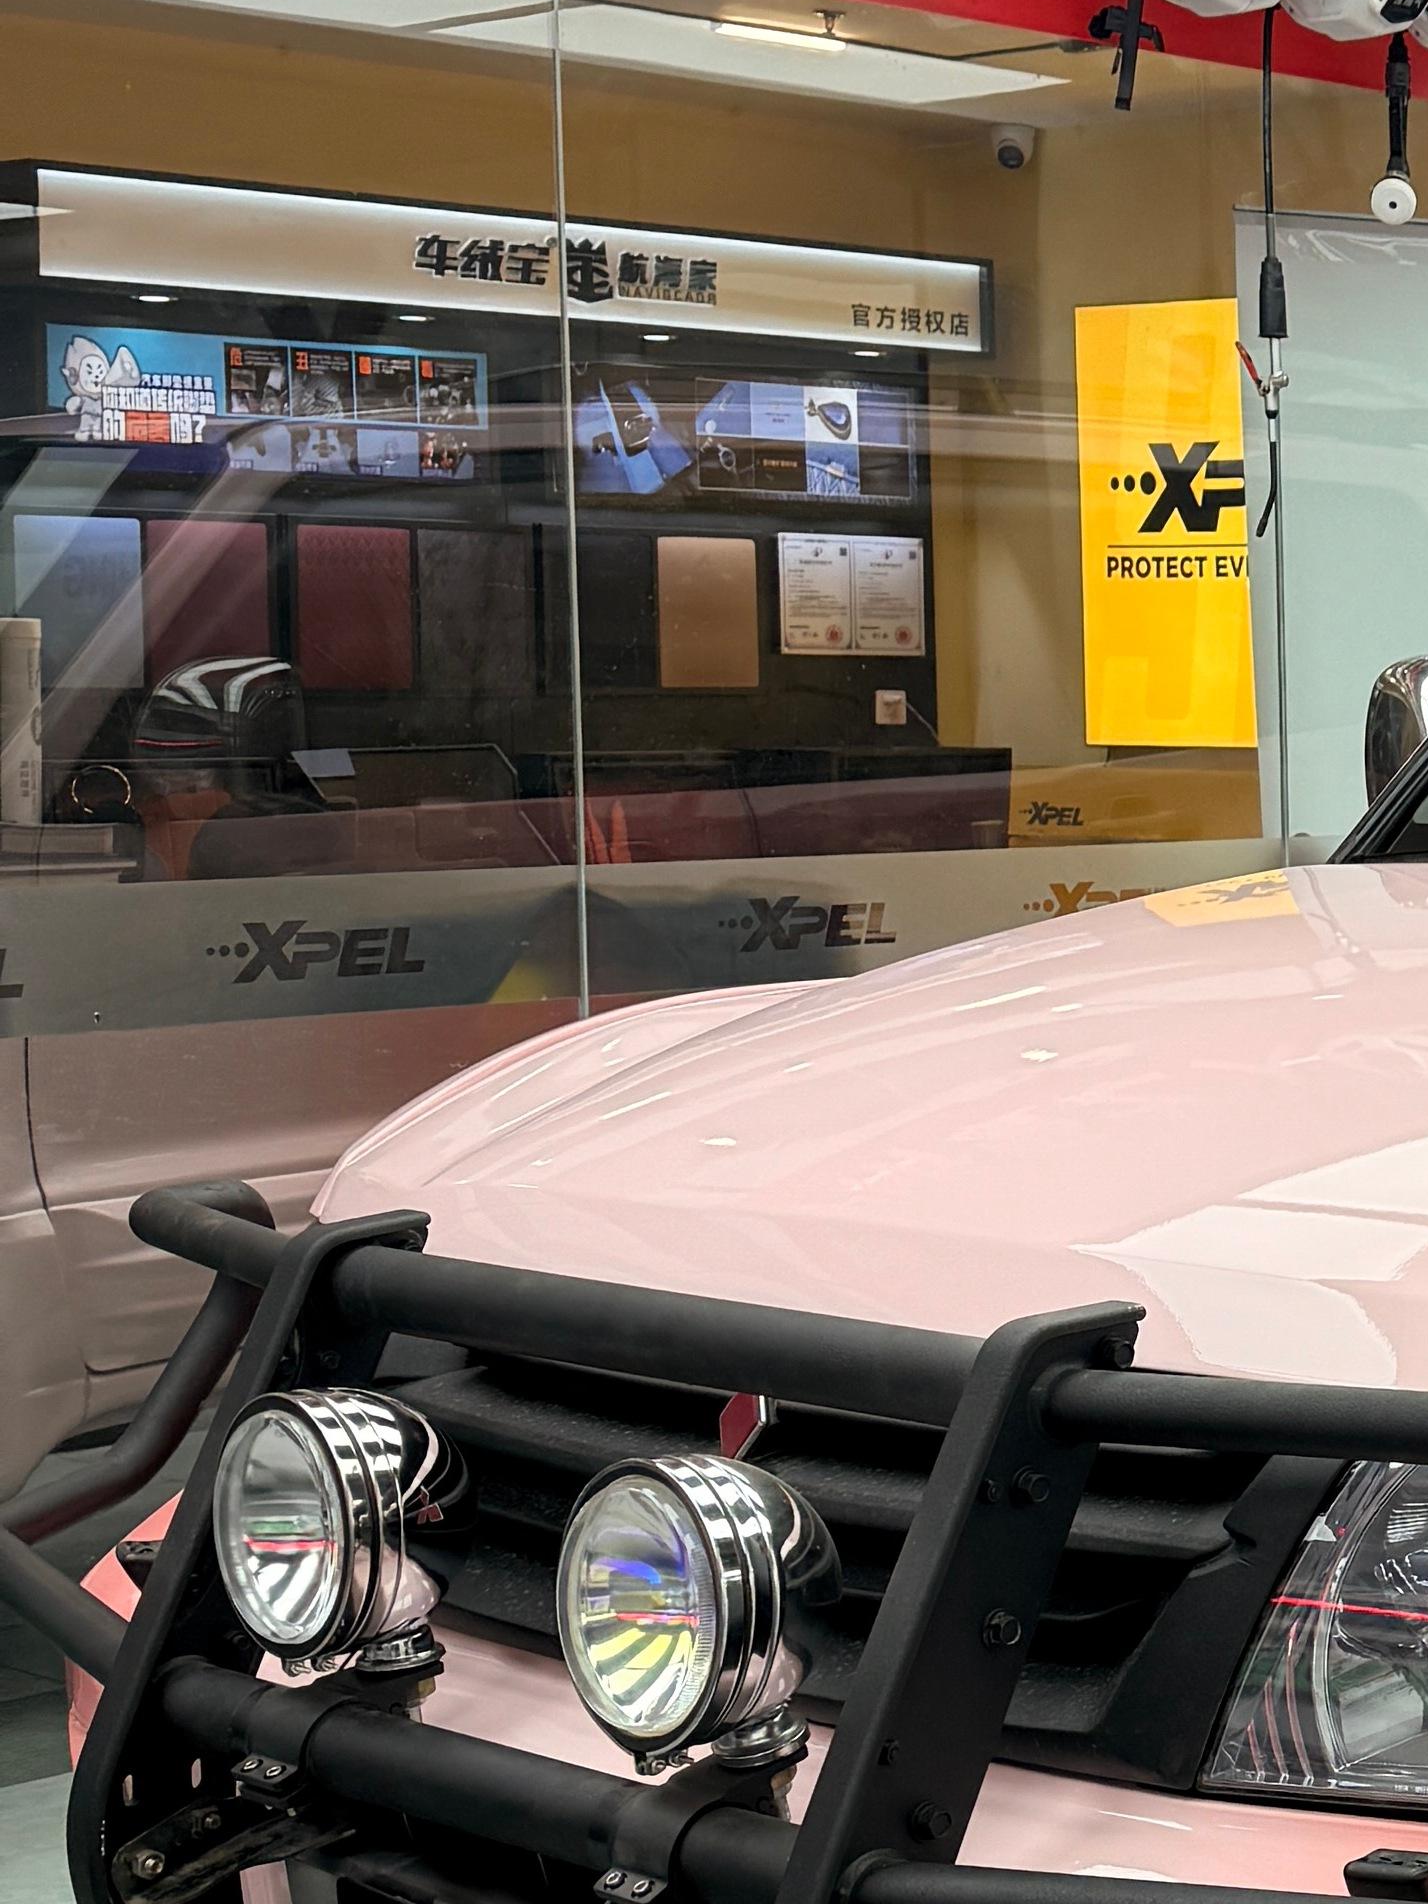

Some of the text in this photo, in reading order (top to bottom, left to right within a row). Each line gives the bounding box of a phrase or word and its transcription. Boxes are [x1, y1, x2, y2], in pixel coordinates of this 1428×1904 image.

[851, 303, 969, 336] 官方授权店
[1106, 555, 1249, 579] PROTECT EV
[1026, 801, 1085, 827] XPEL
[739, 896, 897, 952] XPEL
[232, 920, 425, 984] XPEL
